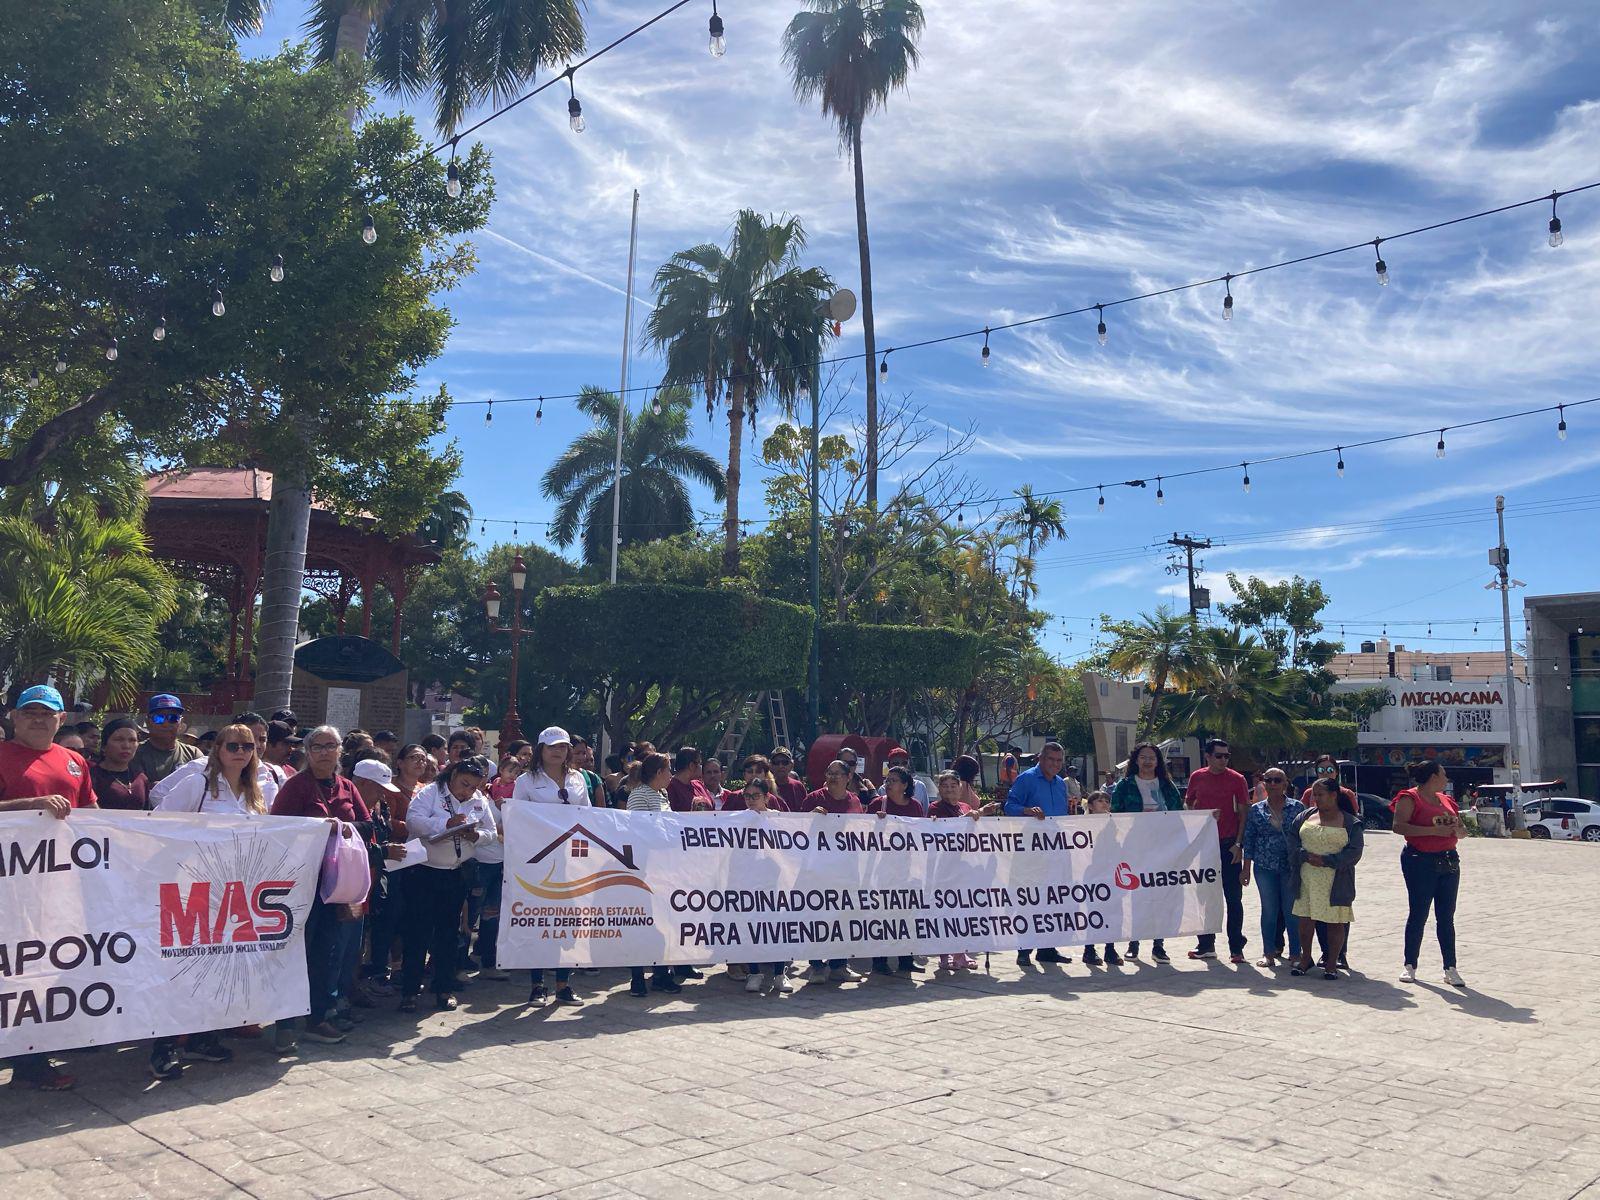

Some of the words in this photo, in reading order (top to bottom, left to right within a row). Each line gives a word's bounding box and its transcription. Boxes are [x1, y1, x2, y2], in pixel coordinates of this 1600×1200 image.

[1401, 690, 1503, 707] MICHOACANA
[681, 826, 810, 851] ¡BIENVENIDO
[818, 831, 831, 851] A
[836, 830, 918, 852] SINALOA
[922, 832, 1025, 852] PRESIDENTE
[1031, 830, 1094, 851] AMLO!
[0, 837, 110, 877] MLO!
[1114, 862, 1217, 891] Guasave
[511, 901, 603, 917] COORDINADORA
[606, 906, 647, 917] ESTATAL
[669, 889, 854, 912] COORDINADORA
[859, 889, 931, 911] ESTATAL
[934, 888, 1013, 909] SOLICITA
[1017, 886, 1041, 907] SU
[1047, 883, 1112, 905] APOYO
[160, 881, 296, 946] MAS
[510, 917, 536, 928] POR
[537, 917, 552, 928] EL
[553, 917, 606, 928] DERECHO
[607, 916, 655, 927] HUMANO
[542, 930, 551, 939] A
[552, 929, 568, 939] LA
[572, 929, 623, 939] VIVIENDA
[680, 922, 742, 946] PARA
[748, 921, 844, 945] VIVIENDA
[850, 919, 911, 942] DIGNA
[915, 918, 940, 940] EN
[944, 914, 1029, 938] NUESTRO
[1032, 911, 1110, 933] ESTADO.
[207, 945, 234, 956] AMPLIO
[235, 943, 258, 954] SOCIAL
